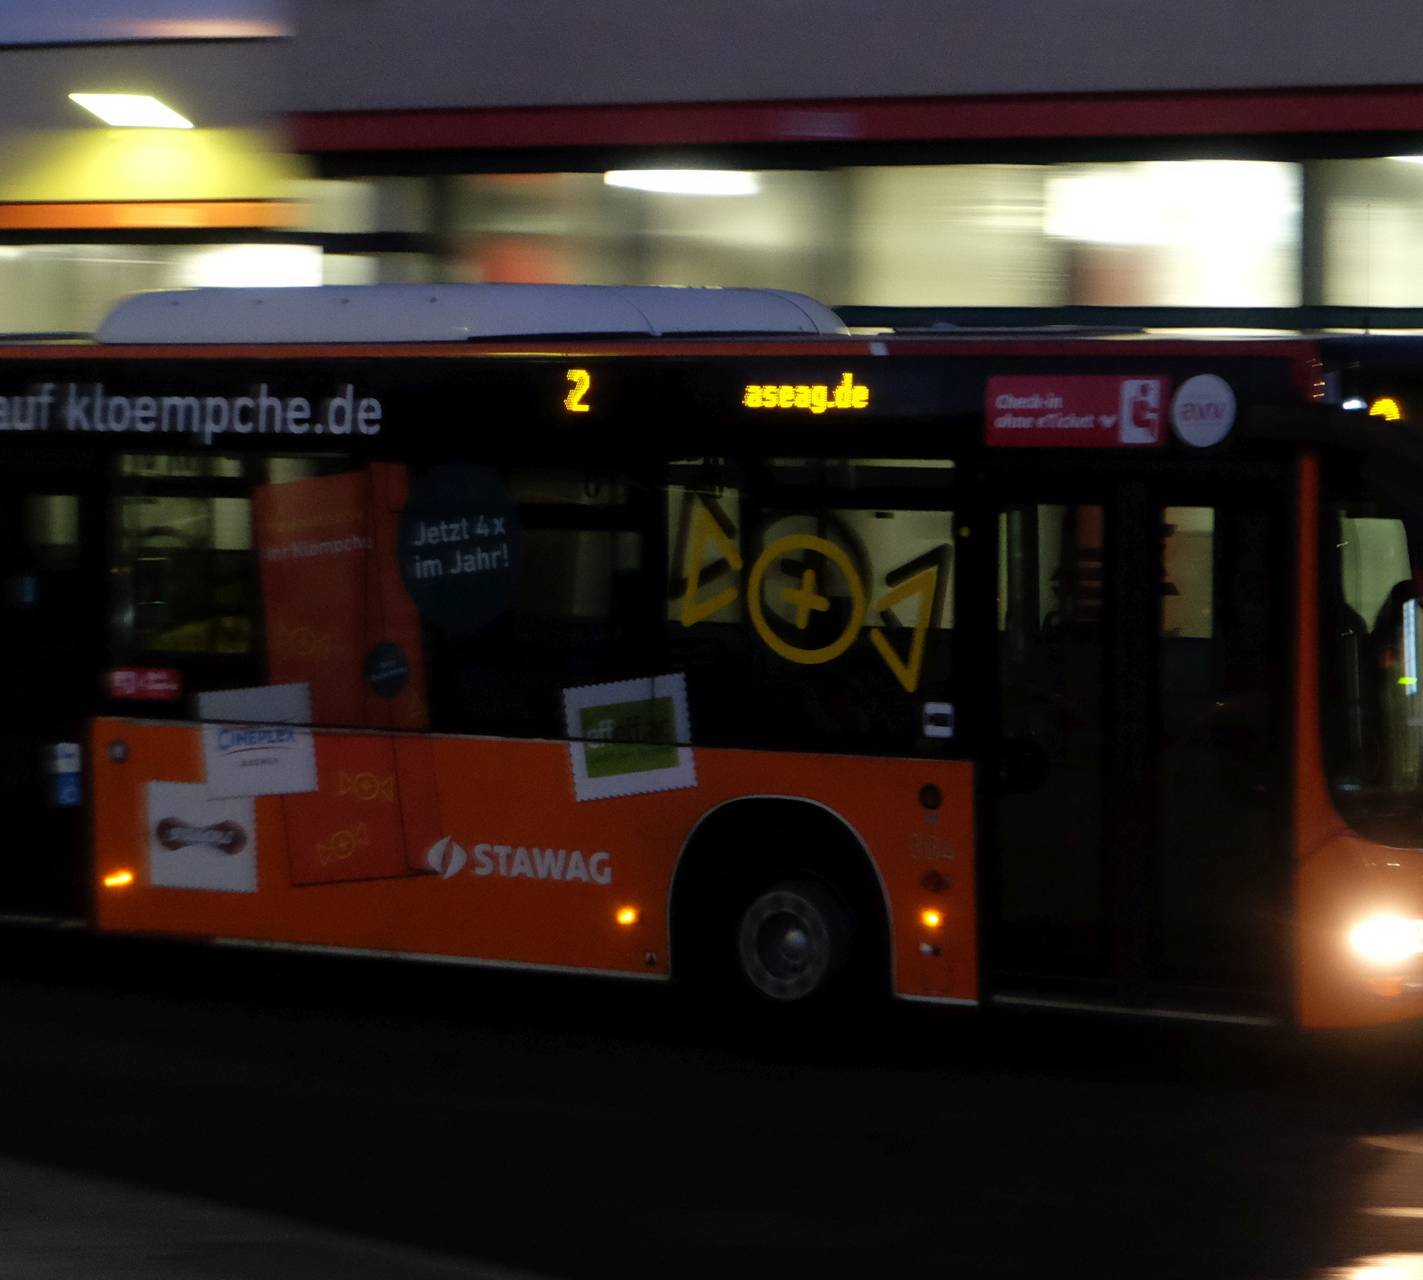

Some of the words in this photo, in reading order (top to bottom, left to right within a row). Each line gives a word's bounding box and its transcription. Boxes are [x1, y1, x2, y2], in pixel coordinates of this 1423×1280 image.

[565, 369, 590, 412] 2
[742, 372, 869, 414] aseag.de
[995, 392, 1063, 409] Check-in
[66, 382, 384, 446] kloempche.de
[414, 517, 469, 546] Jetzt
[415, 554, 443, 579] im
[449, 544, 510, 575] Jahr!
[219, 728, 294, 751] CINEPLEX
[473, 843, 613, 885] STAWAG
